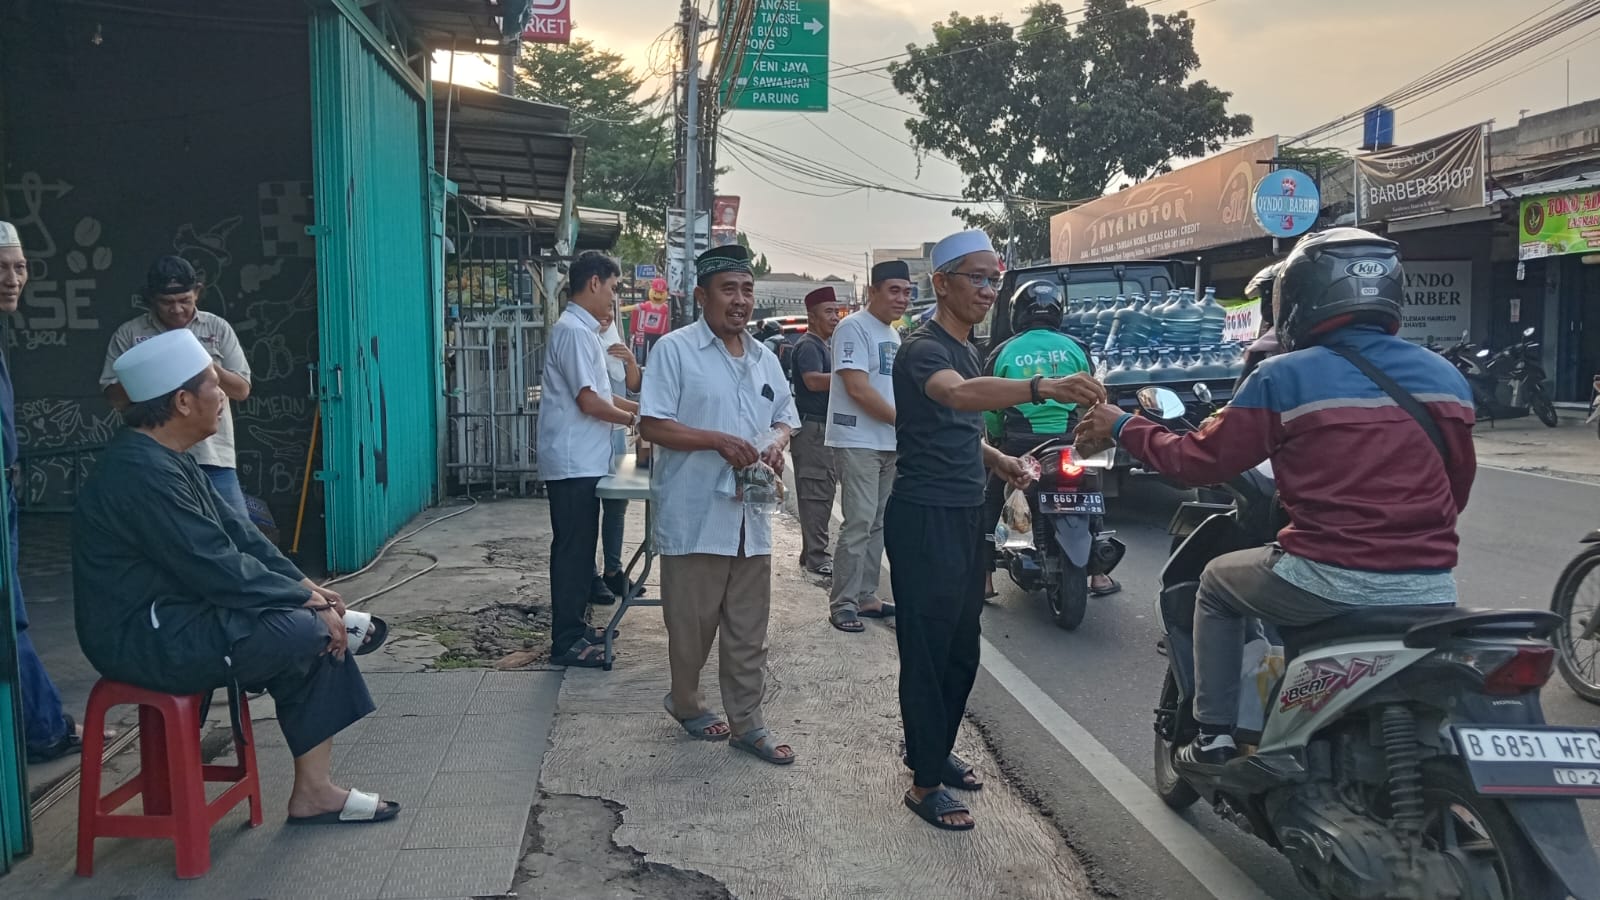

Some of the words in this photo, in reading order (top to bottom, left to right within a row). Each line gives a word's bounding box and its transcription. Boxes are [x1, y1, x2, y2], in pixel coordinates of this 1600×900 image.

[761, 13, 801, 25] TANGSEL
[757, 26, 788, 38] BULUS
[752, 61, 778, 72] RENI
[782, 62, 808, 73] JAYA
[752, 76, 810, 89] SAWANGAN
[752, 92, 800, 104] PARUNG
[1370, 166, 1475, 205] BARBERSHOP
[1289, 197, 1319, 214] BARBER
[1090, 216, 1124, 247] JAYA
[1127, 198, 1187, 232] MOTOR
[1147, 232, 1163, 242] BEKAS
[1164, 227, 1178, 239] CASH
[1181, 222, 1201, 235] CREDIT
[1405, 272, 1454, 287] YNDO
[1405, 291, 1461, 305] ARBER
[1040, 494, 1047, 503] B
[1053, 494, 1078, 503] 6667
[1467, 733, 1484, 757] B
[1491, 734, 1547, 758] 6851
